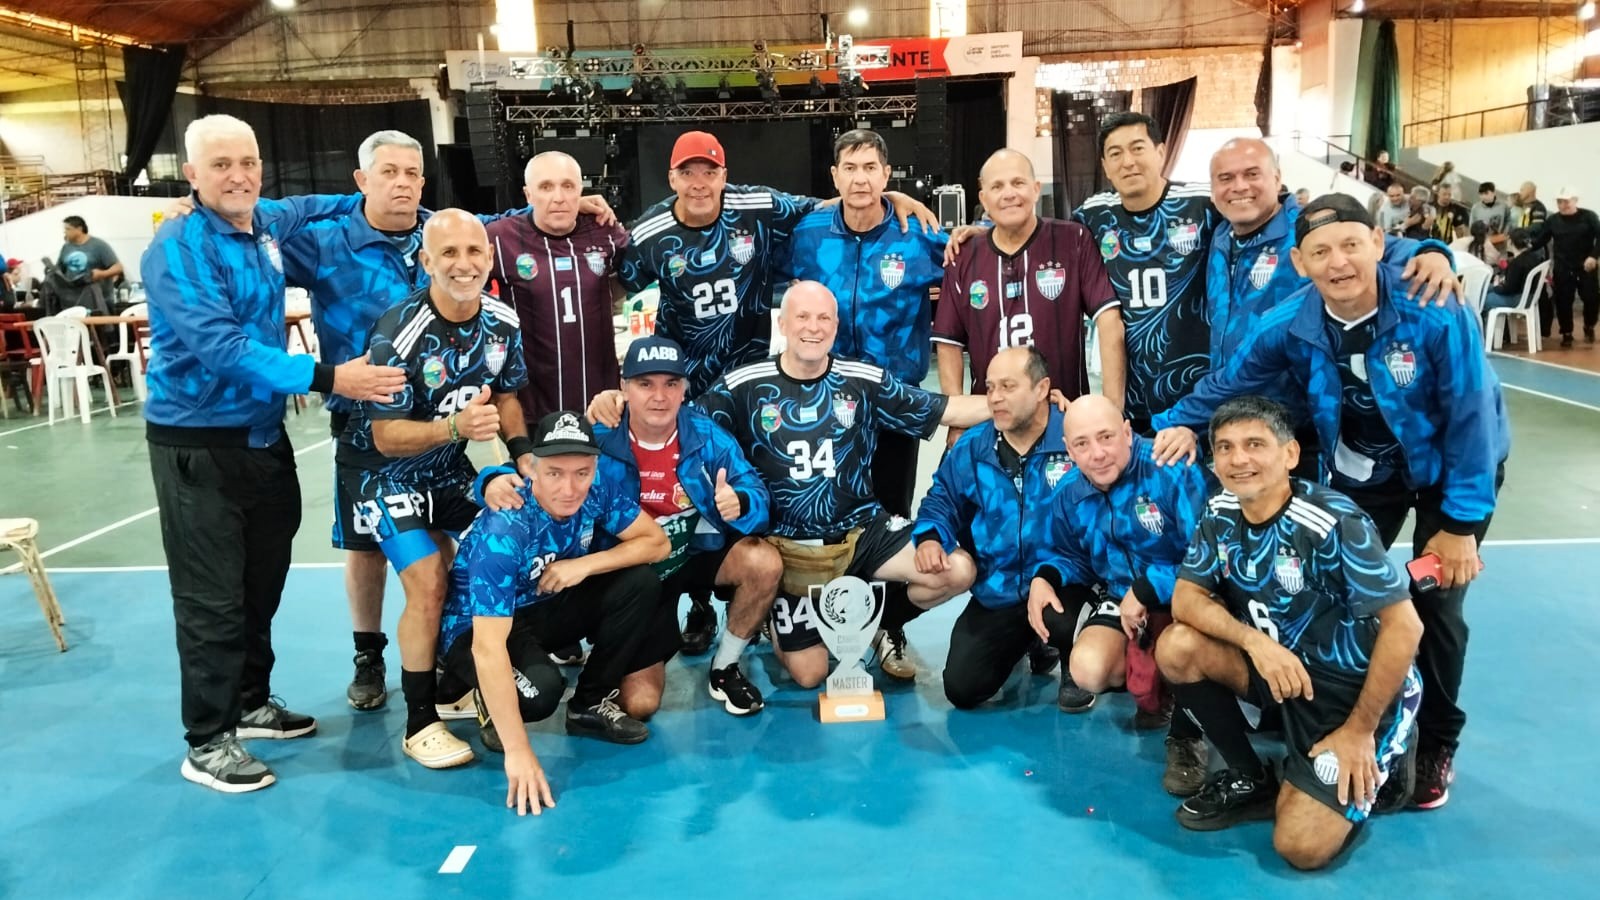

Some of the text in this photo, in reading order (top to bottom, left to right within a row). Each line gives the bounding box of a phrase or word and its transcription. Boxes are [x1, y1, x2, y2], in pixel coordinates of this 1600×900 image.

[560, 286, 577, 324] 1
[692, 278, 739, 319] 23
[1127, 267, 1168, 308] 10
[998, 313, 1034, 351] 12
[637, 346, 678, 362] AABB
[787, 439, 836, 479] 34
[640, 489, 667, 500] reluz
[773, 596, 818, 635] 34
[832, 676, 868, 689] MASTER
